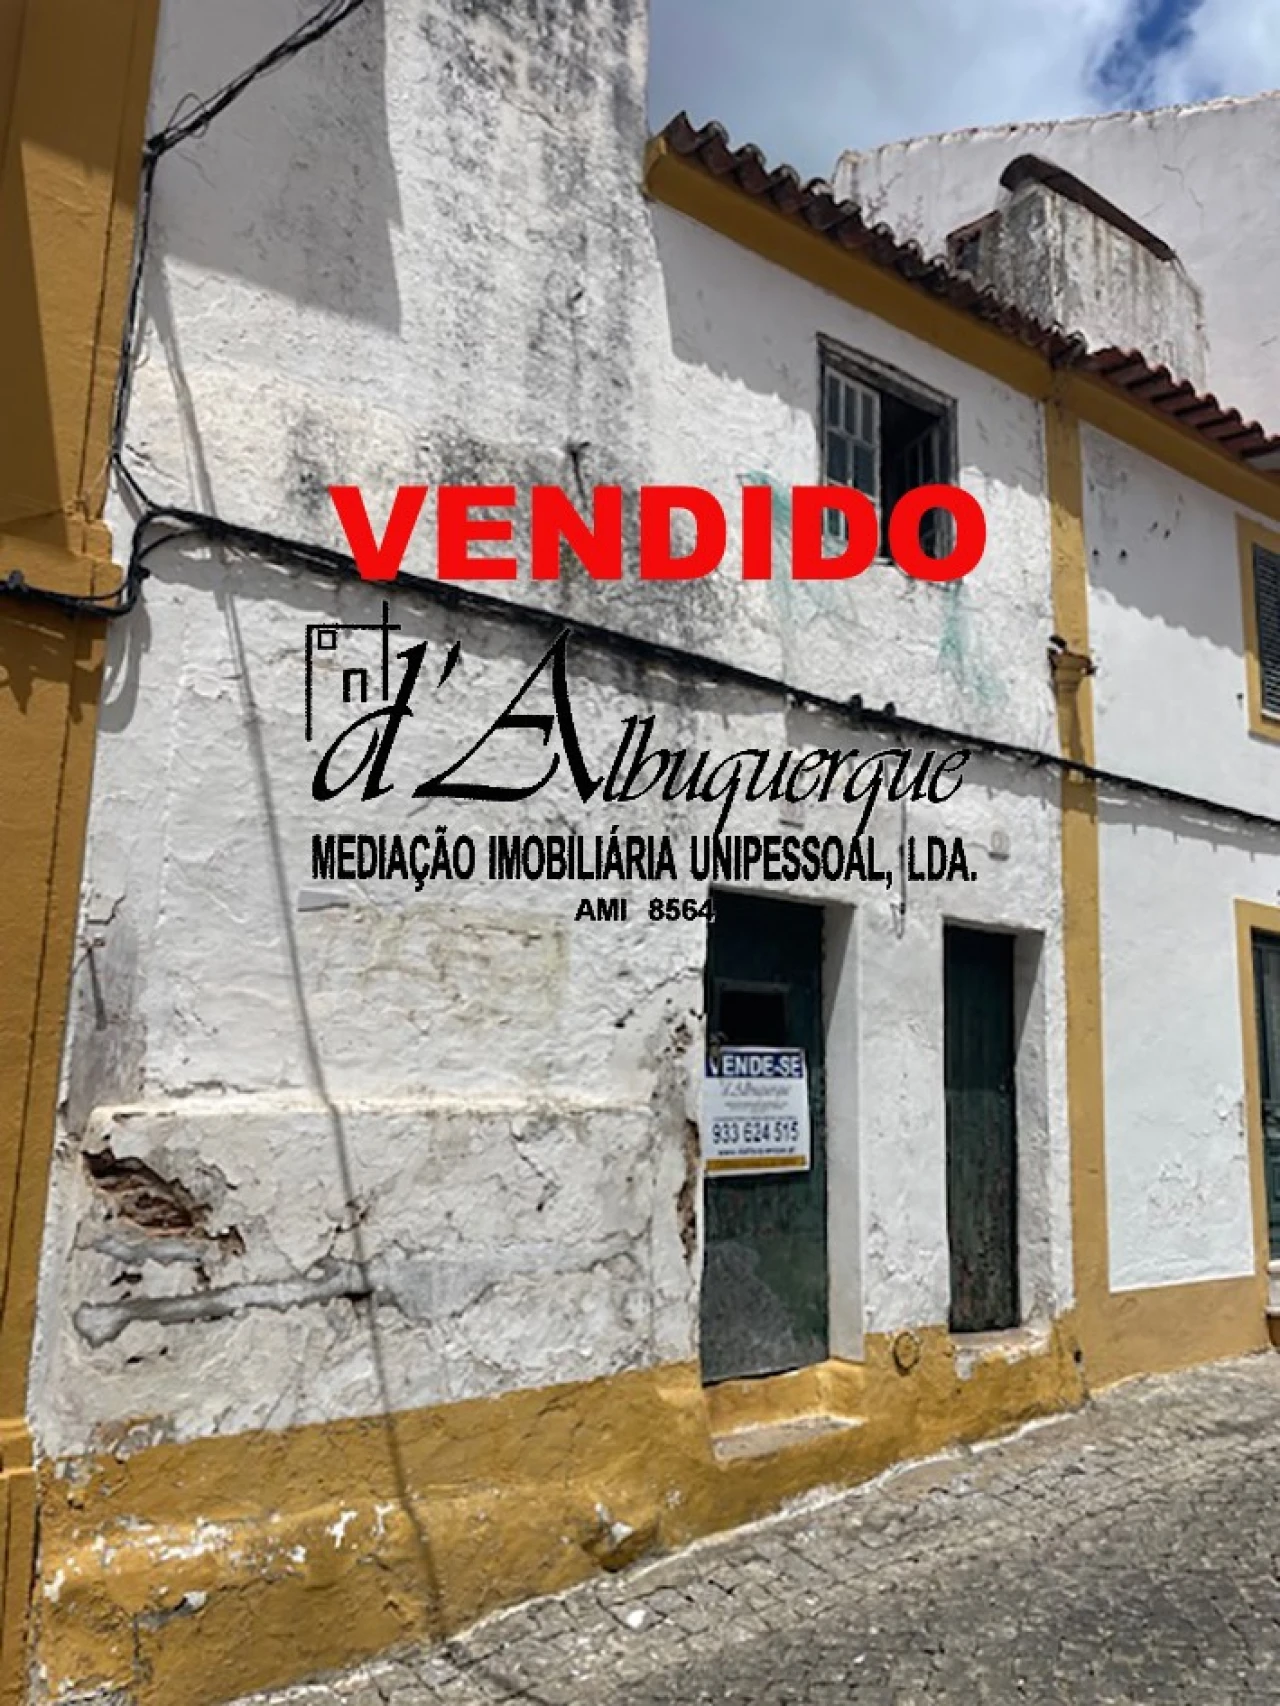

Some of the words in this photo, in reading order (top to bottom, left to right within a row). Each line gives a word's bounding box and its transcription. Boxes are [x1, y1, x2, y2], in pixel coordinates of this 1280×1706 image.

[712, 1122, 740, 1145] 933
[743, 1122, 770, 1144] 624
[773, 1120, 800, 1142] 515
